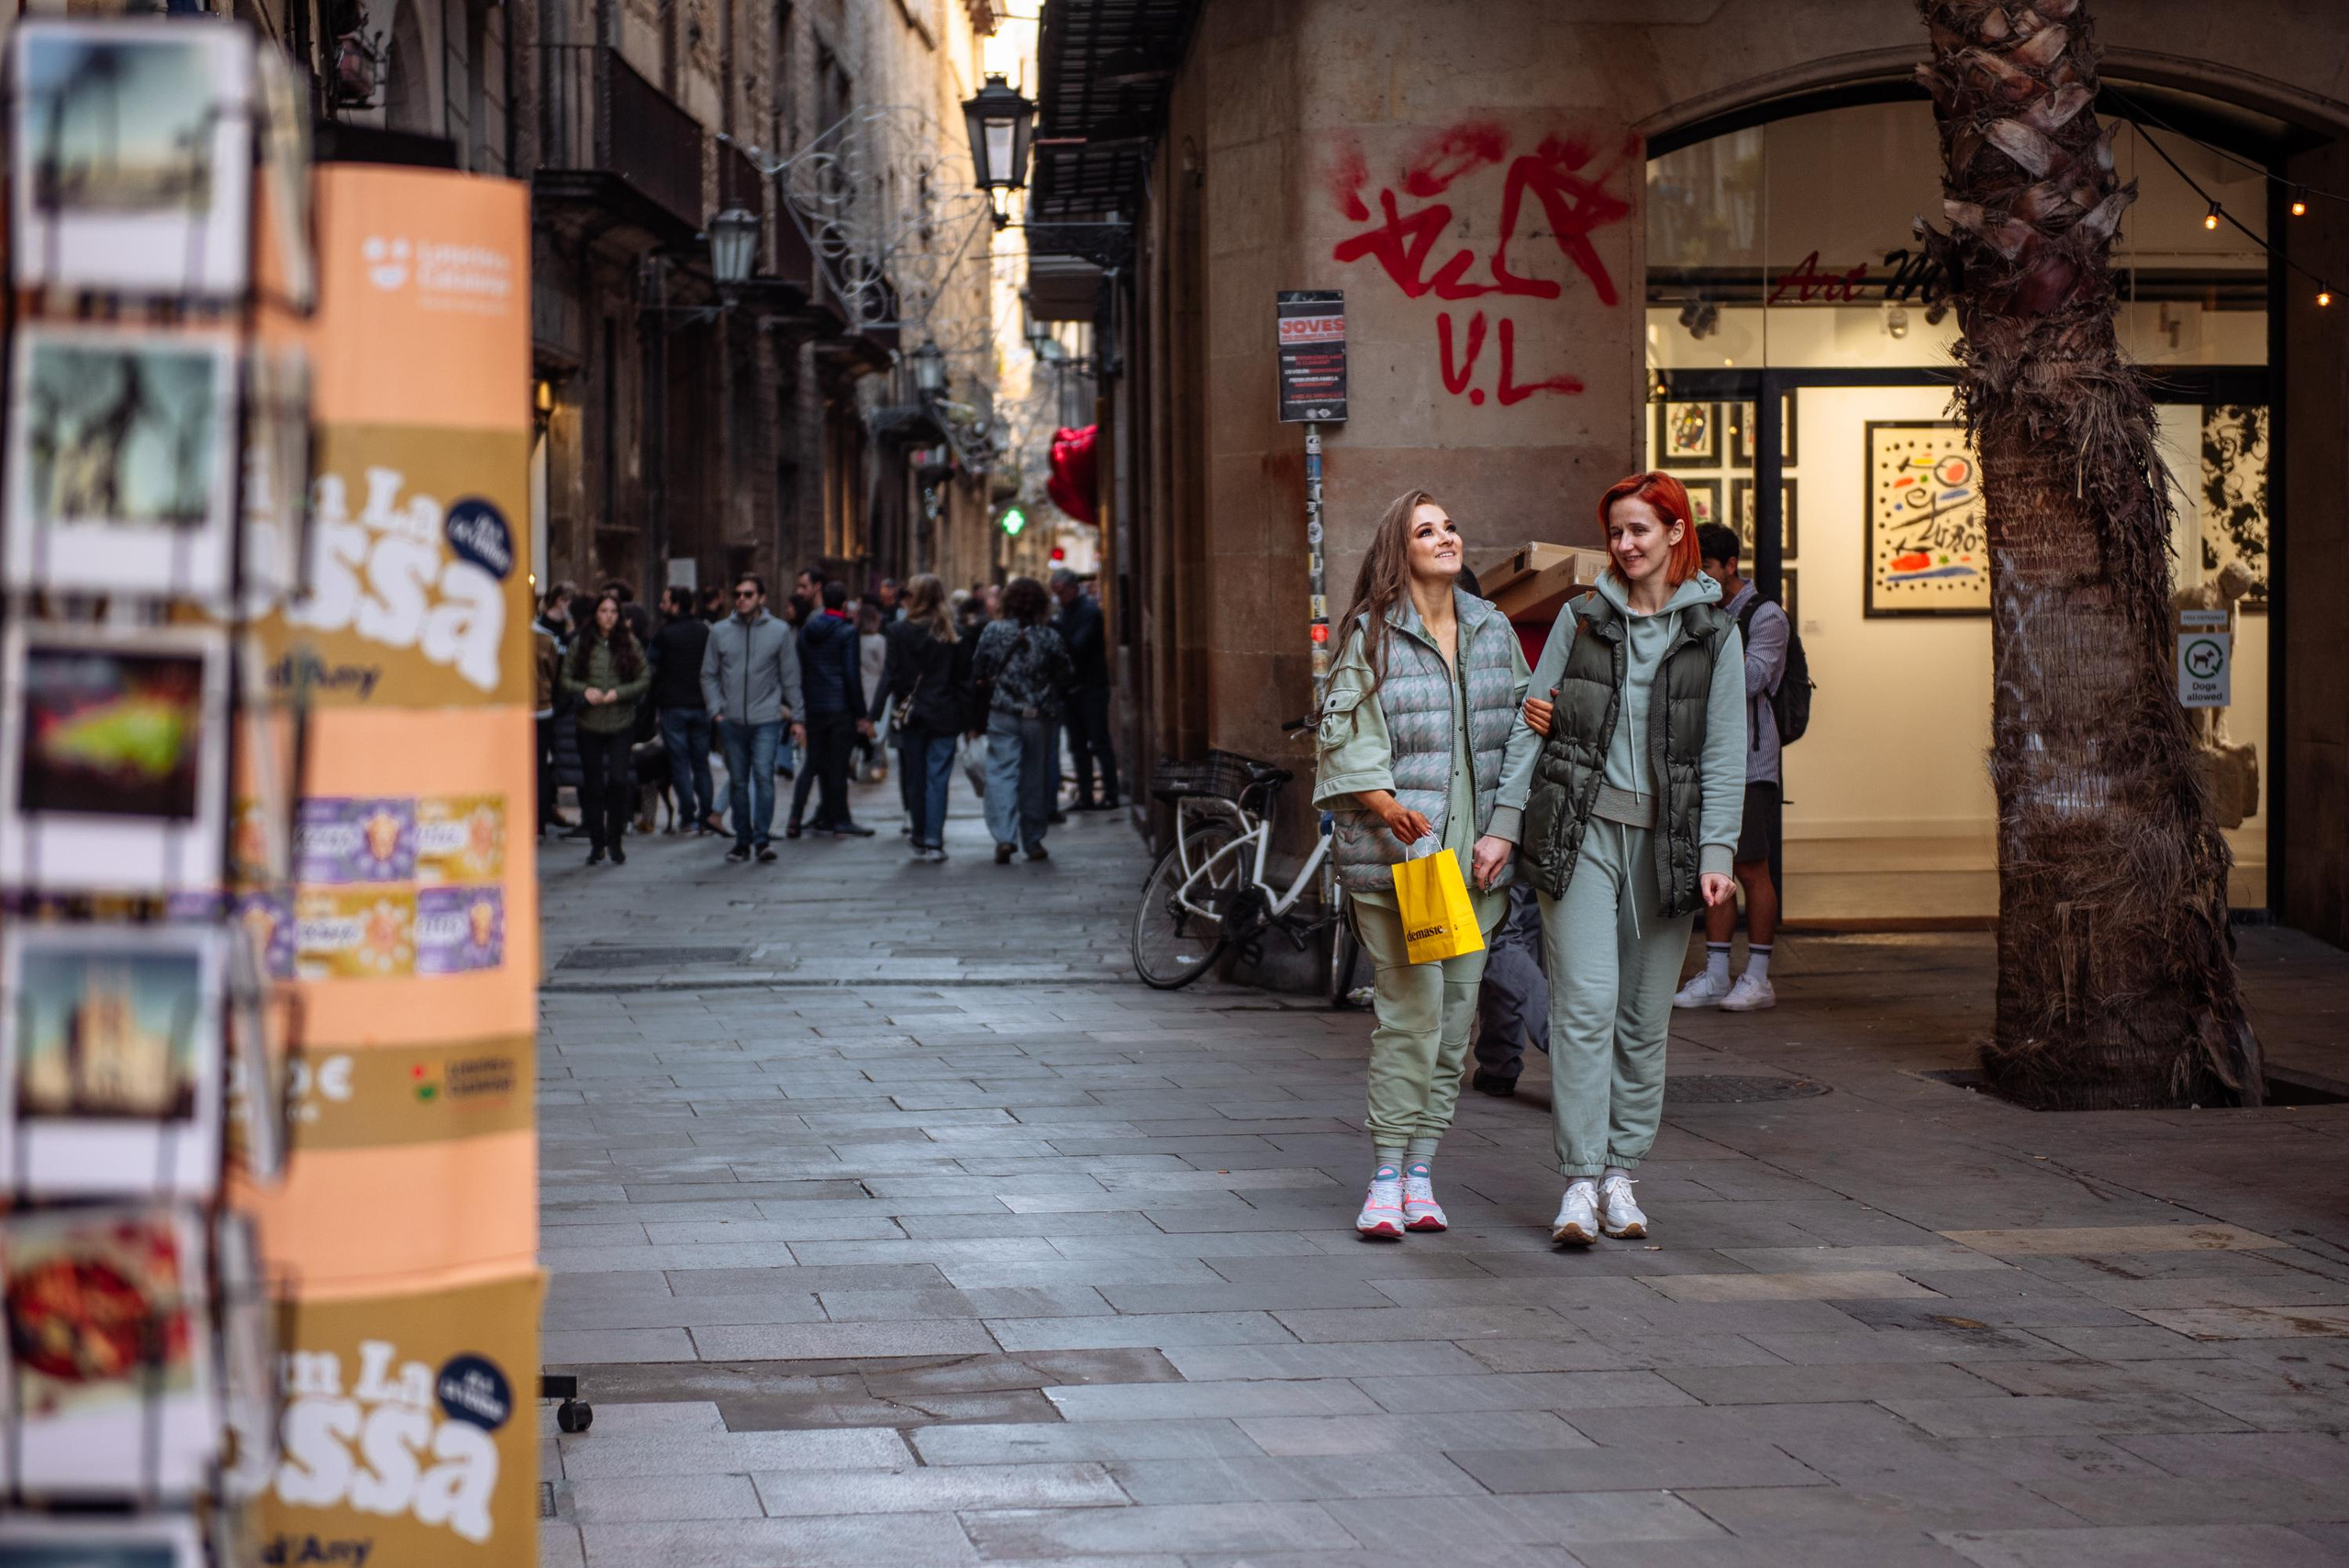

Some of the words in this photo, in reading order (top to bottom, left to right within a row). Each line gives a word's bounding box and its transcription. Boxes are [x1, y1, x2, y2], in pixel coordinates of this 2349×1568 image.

[1767, 250, 1867, 306] Art
[1280, 318, 1345, 335] JOVES
[2192, 682, 2217, 692] Dogs
[2187, 693, 2223, 701] allowed
